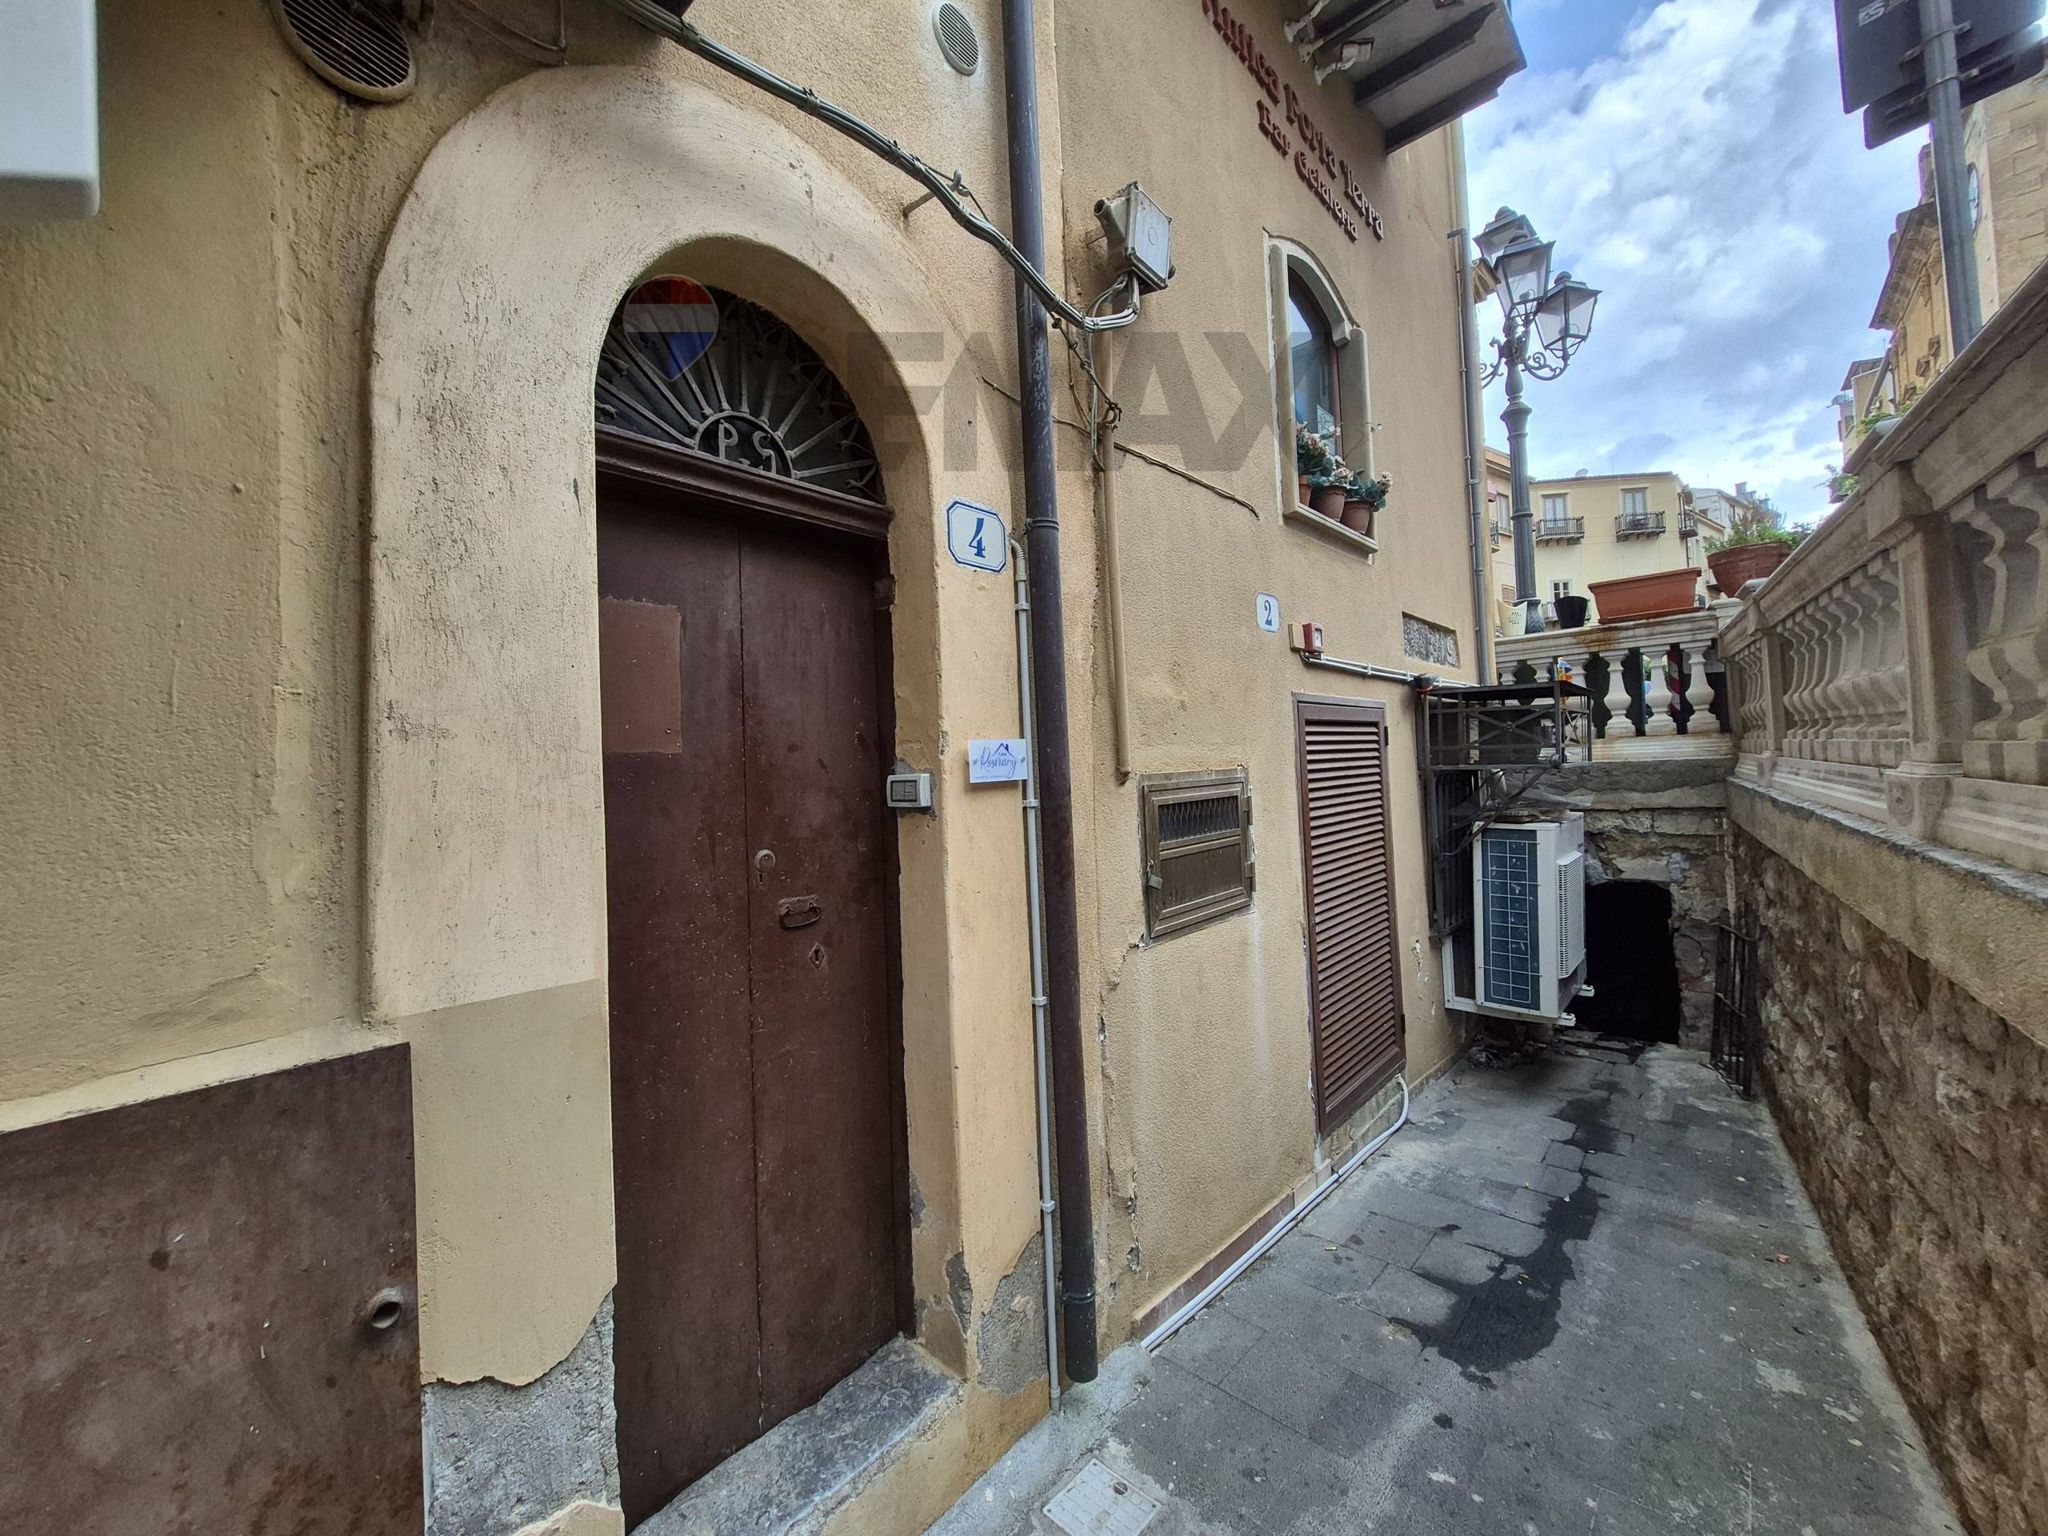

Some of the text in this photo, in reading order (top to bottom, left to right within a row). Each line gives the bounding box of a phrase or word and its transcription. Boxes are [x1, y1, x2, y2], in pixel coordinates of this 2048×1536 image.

[1283, 83, 1338, 180] Porta
[1339, 159, 1385, 242] Terra
[968, 517, 986, 559] 4
[1264, 599, 1273, 626] 2
